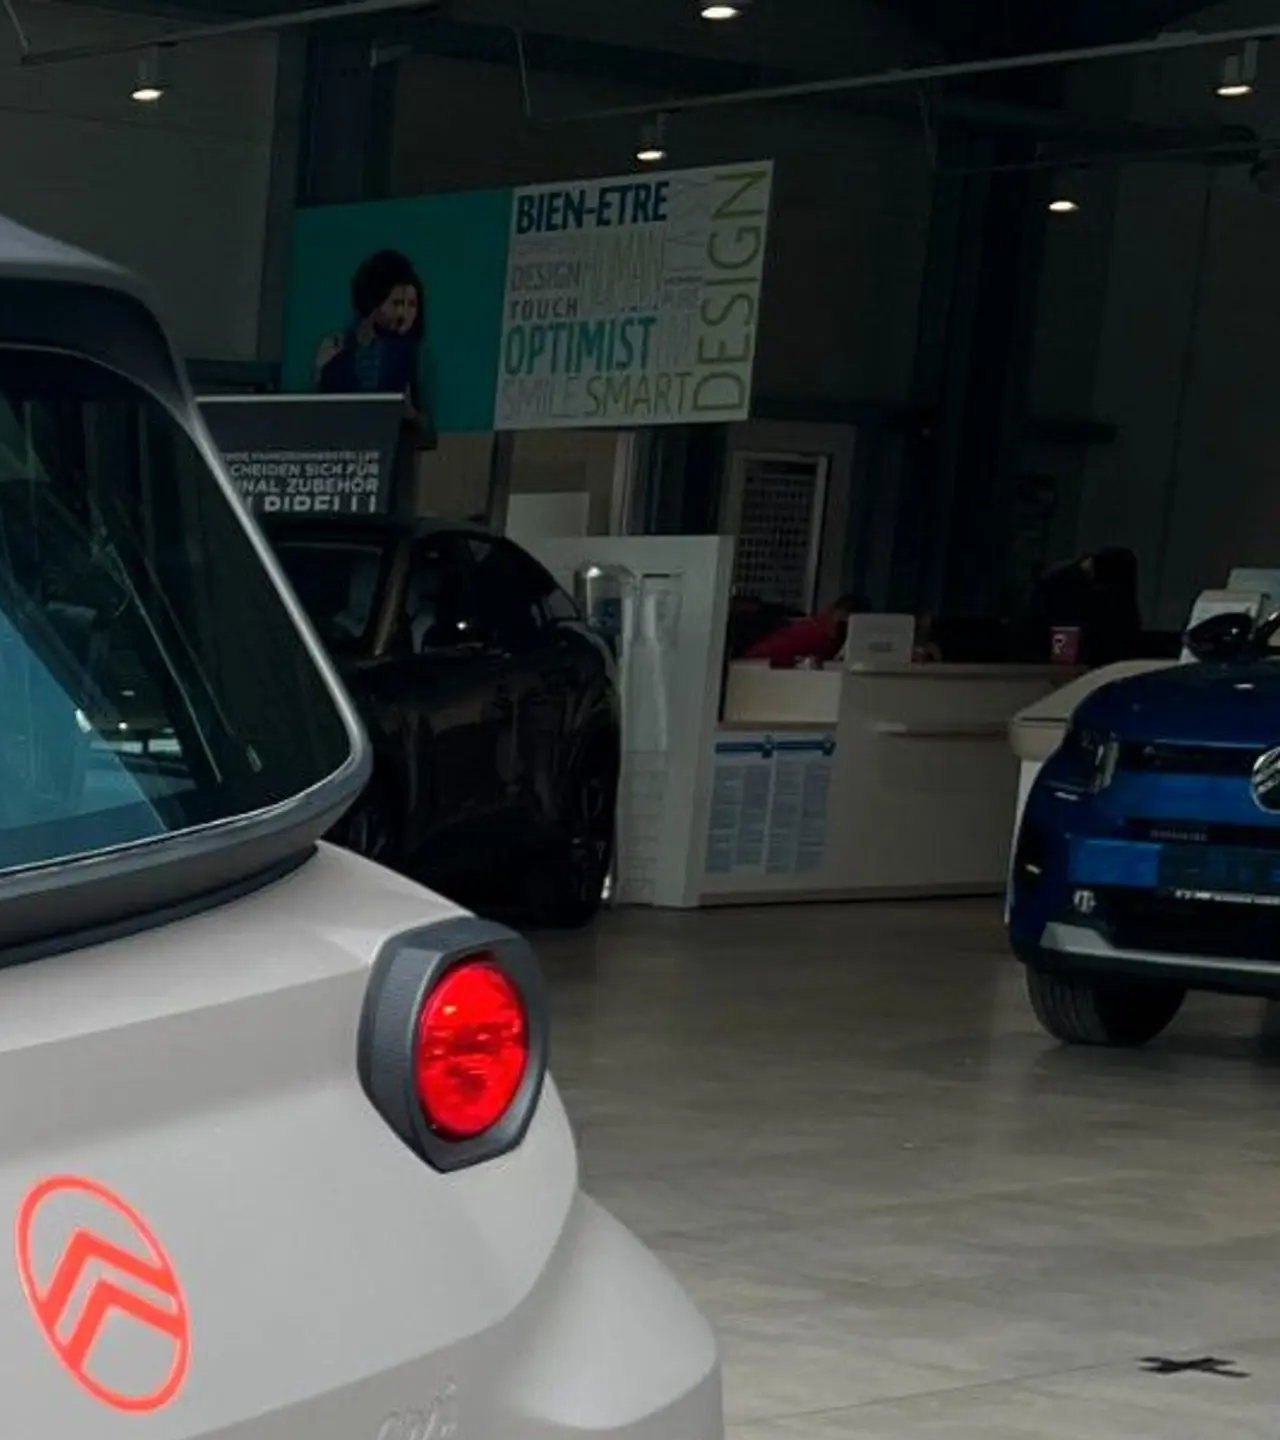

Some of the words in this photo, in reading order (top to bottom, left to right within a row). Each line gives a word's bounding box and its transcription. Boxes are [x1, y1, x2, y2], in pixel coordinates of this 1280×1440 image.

[517, 181, 671, 234] BIEN-ETRE
[510, 296, 579, 321] TOUCH
[694, 170, 769, 413] DESIGN
[505, 316, 658, 375] OPTIMIST
[586, 371, 695, 416] SMART
